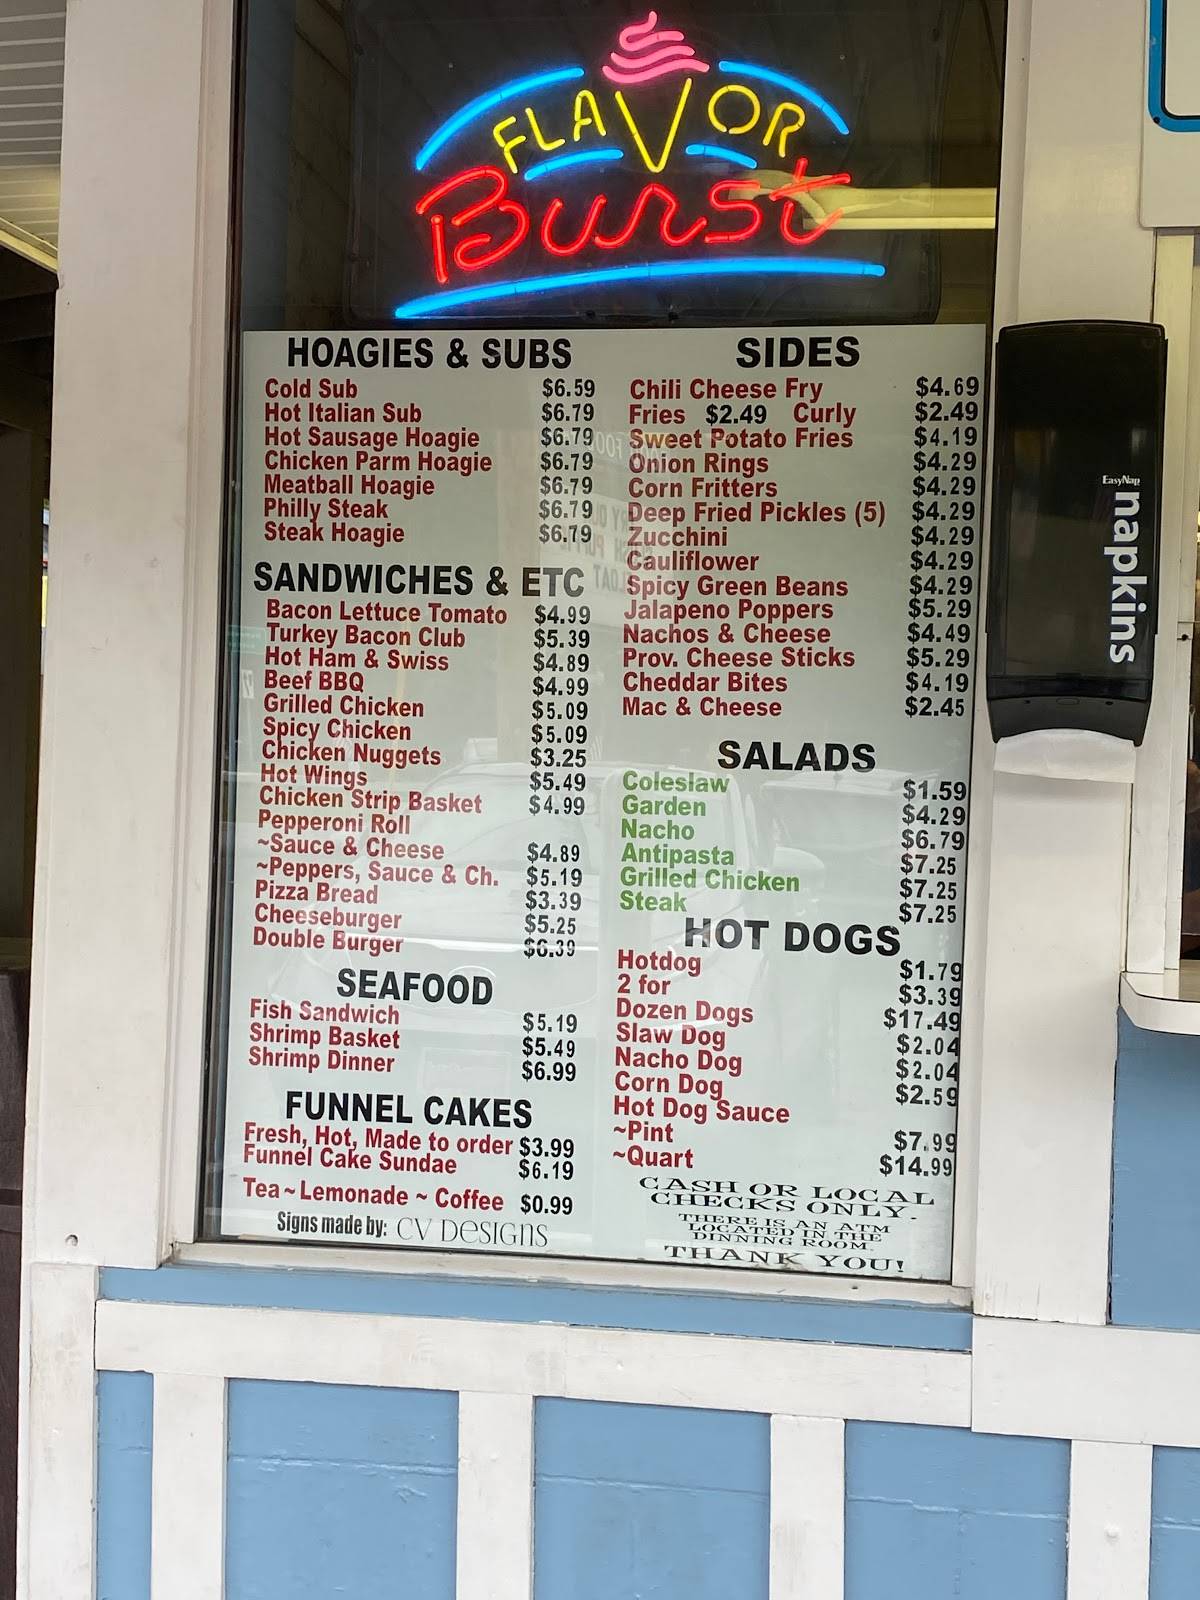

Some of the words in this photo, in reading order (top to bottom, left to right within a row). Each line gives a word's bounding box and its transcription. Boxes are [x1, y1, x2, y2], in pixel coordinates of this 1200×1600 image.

[492, 77, 806, 174] FLAVOR
[415, 157, 851, 285] Burst
[287, 337, 434, 368] HOAGIES
[446, 338, 469, 368] &
[482, 338, 572, 369] SUBS
[736, 336, 859, 368] SIDES
[265, 379, 311, 399] Cold
[318, 378, 357, 399] Sub
[542, 378, 595, 400] $6.59
[630, 380, 681, 399] Chili
[690, 380, 777, 399] Cheese
[786, 378, 823, 402] Fry
[916, 376, 979, 399] $4.69
[264, 403, 301, 422] Hot
[308, 403, 375, 423] Italian
[382, 403, 422, 423] Sub
[541, 402, 595, 422] $6.79
[629, 405, 686, 424] Fries
[706, 405, 767, 425] $2.49
[793, 403, 856, 428] Curly
[915, 401, 979, 423] $2.49
[264, 427, 301, 446] Hot
[308, 427, 398, 452] Sausage
[405, 427, 480, 452] Hoagie
[541, 427, 593, 447] $6.79
[264, 450, 348, 471] Chicken
[356, 452, 410, 471] Parm
[418, 452, 492, 476] Hoagie
[540, 452, 593, 472] $6.79
[264, 474, 353, 494] Meatball
[361, 475, 435, 500] Hoagie
[540, 475, 593, 496] $6.79
[629, 478, 683, 498] Corn
[691, 478, 777, 498] Fritters
[913, 476, 976, 497] $4.29
[1102, 474, 1141, 486] EasyNap
[254, 562, 473, 596] SANDWICHES
[486, 566, 509, 597] &
[522, 567, 584, 597] ETC
[1103, 491, 1147, 664] napkins
[267, 599, 332, 620] Bacon
[340, 601, 421, 622] Lettuce
[429, 603, 507, 624] Tomato
[535, 605, 591, 625] $4.99
[267, 624, 337, 648] Turkey
[345, 625, 410, 645] Bacon
[418, 627, 465, 647] Club
[534, 629, 590, 649] $5.39
[624, 624, 709, 644] Nachos
[719, 624, 734, 643] &
[743, 624, 831, 644] Cheese
[907, 622, 971, 644] $4.49
[265, 647, 301, 666] Hot
[309, 648, 356, 667] Ham
[364, 649, 379, 669] &
[387, 650, 449, 670] Swiss
[533, 653, 590, 673] $4.89
[623, 648, 678, 668] Prov.
[686, 648, 773, 668] Cheese
[781, 647, 855, 667] Sticks
[907, 647, 970, 668] $5.29
[264, 670, 312, 690] Beef
[319, 671, 364, 692] BBQ
[533, 677, 589, 697] $4.99
[623, 672, 720, 692] Cheddar
[727, 672, 787, 692] Bites
[906, 672, 969, 693] $4.19
[264, 694, 332, 714] Grilled
[340, 695, 424, 717] Chicken
[532, 701, 588, 721] $5.09
[622, 697, 667, 716] Mac
[676, 697, 691, 716] &
[700, 696, 782, 717] Cheese
[905, 696, 965, 718] $2.45
[263, 717, 319, 742] Spicy
[327, 719, 411, 740] Chicken
[531, 725, 587, 744] $5.09
[262, 741, 345, 761] Chicken
[353, 744, 441, 769] Nuggets
[530, 748, 586, 769] $3.25
[717, 740, 875, 772] SALADS
[261, 764, 297, 783] Hot
[305, 765, 368, 790] Wings
[530, 772, 586, 792] $5.49
[622, 794, 706, 816] Garden
[902, 804, 966, 826] $4.29
[621, 819, 694, 840] Nacho
[901, 828, 965, 851] $6.79
[621, 843, 734, 868] Antipasta
[901, 853, 956, 875] $7.25
[620, 867, 696, 889] Grilled
[705, 869, 800, 892] Chicken
[900, 878, 957, 900] $7.25
[619, 891, 687, 912] Steak
[899, 902, 957, 924] $7.25
[685, 917, 769, 950] HOT
[784, 921, 901, 956] DOGS
[618, 949, 701, 977] Hotdog
[900, 959, 962, 982] $1.79
[336, 968, 493, 1004] SEAFOOD
[618, 974, 631, 994] 2
[638, 974, 671, 994] for
[899, 984, 961, 1006] $3.39
[250, 1022, 321, 1048] Shrimp
[328, 1026, 400, 1048] Basket
[522, 1037, 576, 1058] $5.49
[249, 1046, 320, 1072] Shrimp
[328, 1050, 394, 1072] Dinner
[522, 1061, 576, 1082] $6.99
[286, 1091, 412, 1123] FUNNEL
[424, 1096, 532, 1128] CAKES
[614, 1096, 654, 1117] Hot
[663, 1098, 708, 1124] Dog
[716, 1099, 789, 1123] Sauce
[244, 1122, 307, 1148] Fresh,
[315, 1126, 358, 1151] Hot,
[366, 1128, 422, 1151] Made
[429, 1131, 449, 1152] to
[457, 1132, 513, 1155] order
[519, 1136, 574, 1158] $3.99
[894, 1131, 957, 1153] $7.99
[243, 1144, 312, 1166] Funnel
[320, 1148, 372, 1169] Cake
[379, 1151, 457, 1174] Sundae
[518, 1159, 573, 1181] $6.19
[879, 1154, 952, 1177] $14.99
[639, 1176, 738, 1194] CASH
[750, 1182, 798, 1197] OR
[814, 1186, 934, 1205] LOCAL
[651, 1192, 795, 1212] CHECKS
[806, 1200, 918, 1220] ONLY.
[277, 1211, 318, 1234] Signs
[322, 1215, 362, 1235] made
[366, 1218, 387, 1238] by:
[396, 1217, 432, 1240] CV
[679, 1213, 759, 1226] THERE
[765, 1219, 786, 1228] IS
[796, 1220, 828, 1230] AN
[840, 1223, 890, 1234] ATM
[688, 1223, 794, 1236] LOCATED
[803, 1227, 826, 1238] IN
[834, 1231, 883, 1242] THE
[693, 1232, 793, 1246] DINNING
[664, 1245, 799, 1266] THANK
[818, 1254, 904, 1272] YOU!
